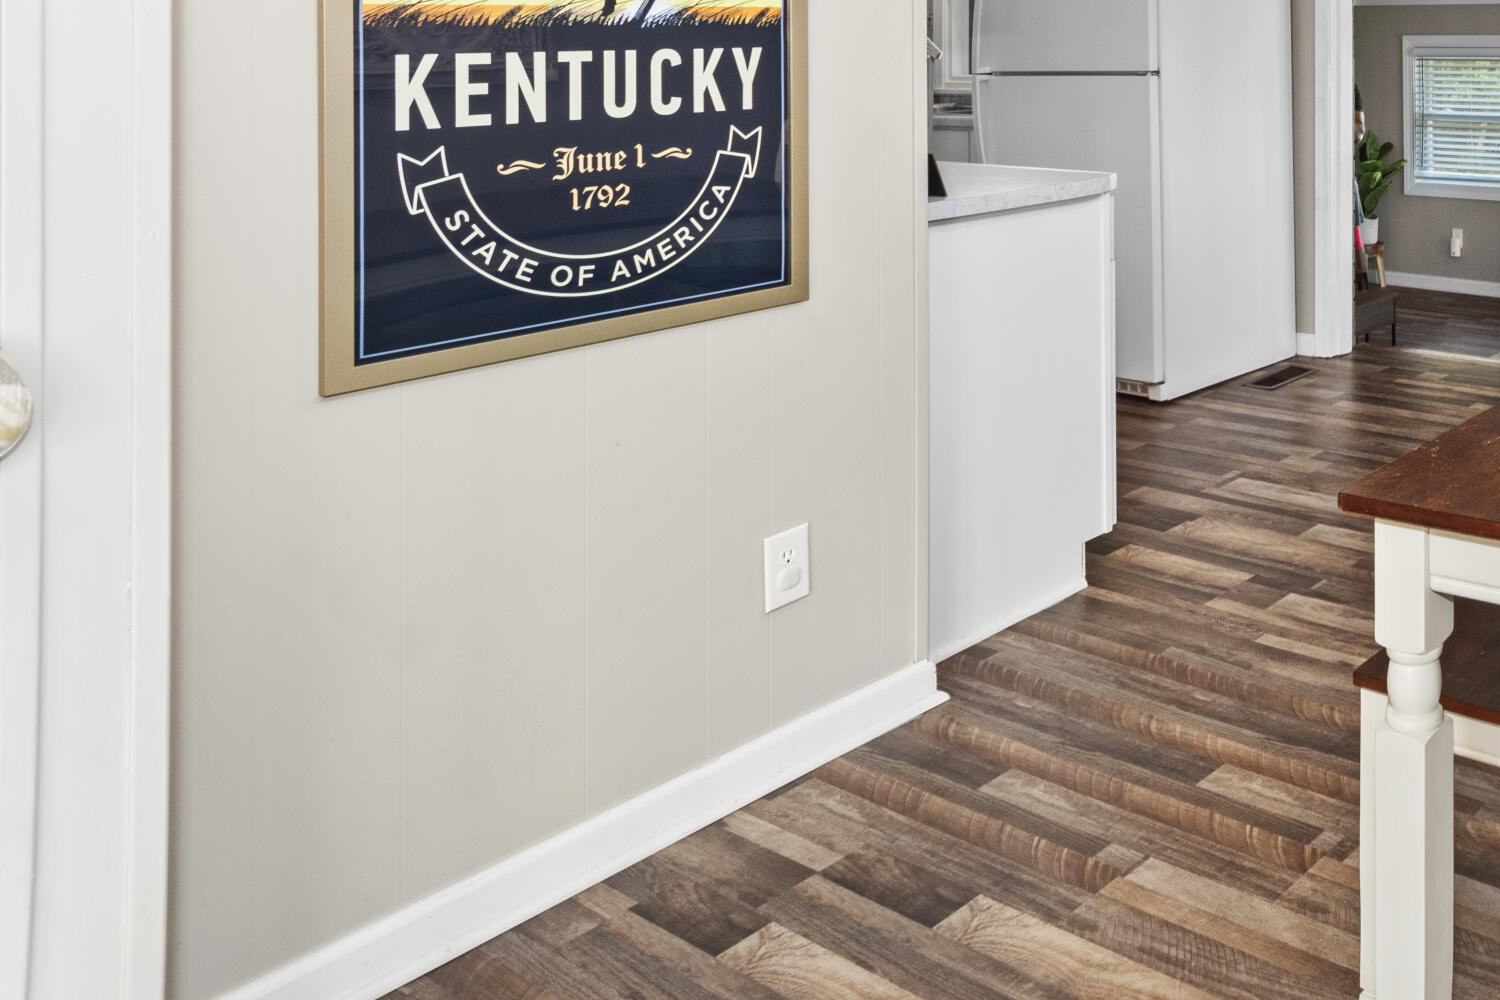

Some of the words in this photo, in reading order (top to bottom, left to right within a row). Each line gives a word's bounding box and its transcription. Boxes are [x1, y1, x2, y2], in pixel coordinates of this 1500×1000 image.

[394, 46, 763, 131] KENTUCKY
[552, 145, 628, 181] June
[635, 144, 646, 169] 1
[569, 183, 631, 212] 1792
[444, 209, 539, 283] STATE
[550, 265, 595, 287] OF
[610, 183, 731, 283] AMERICA
